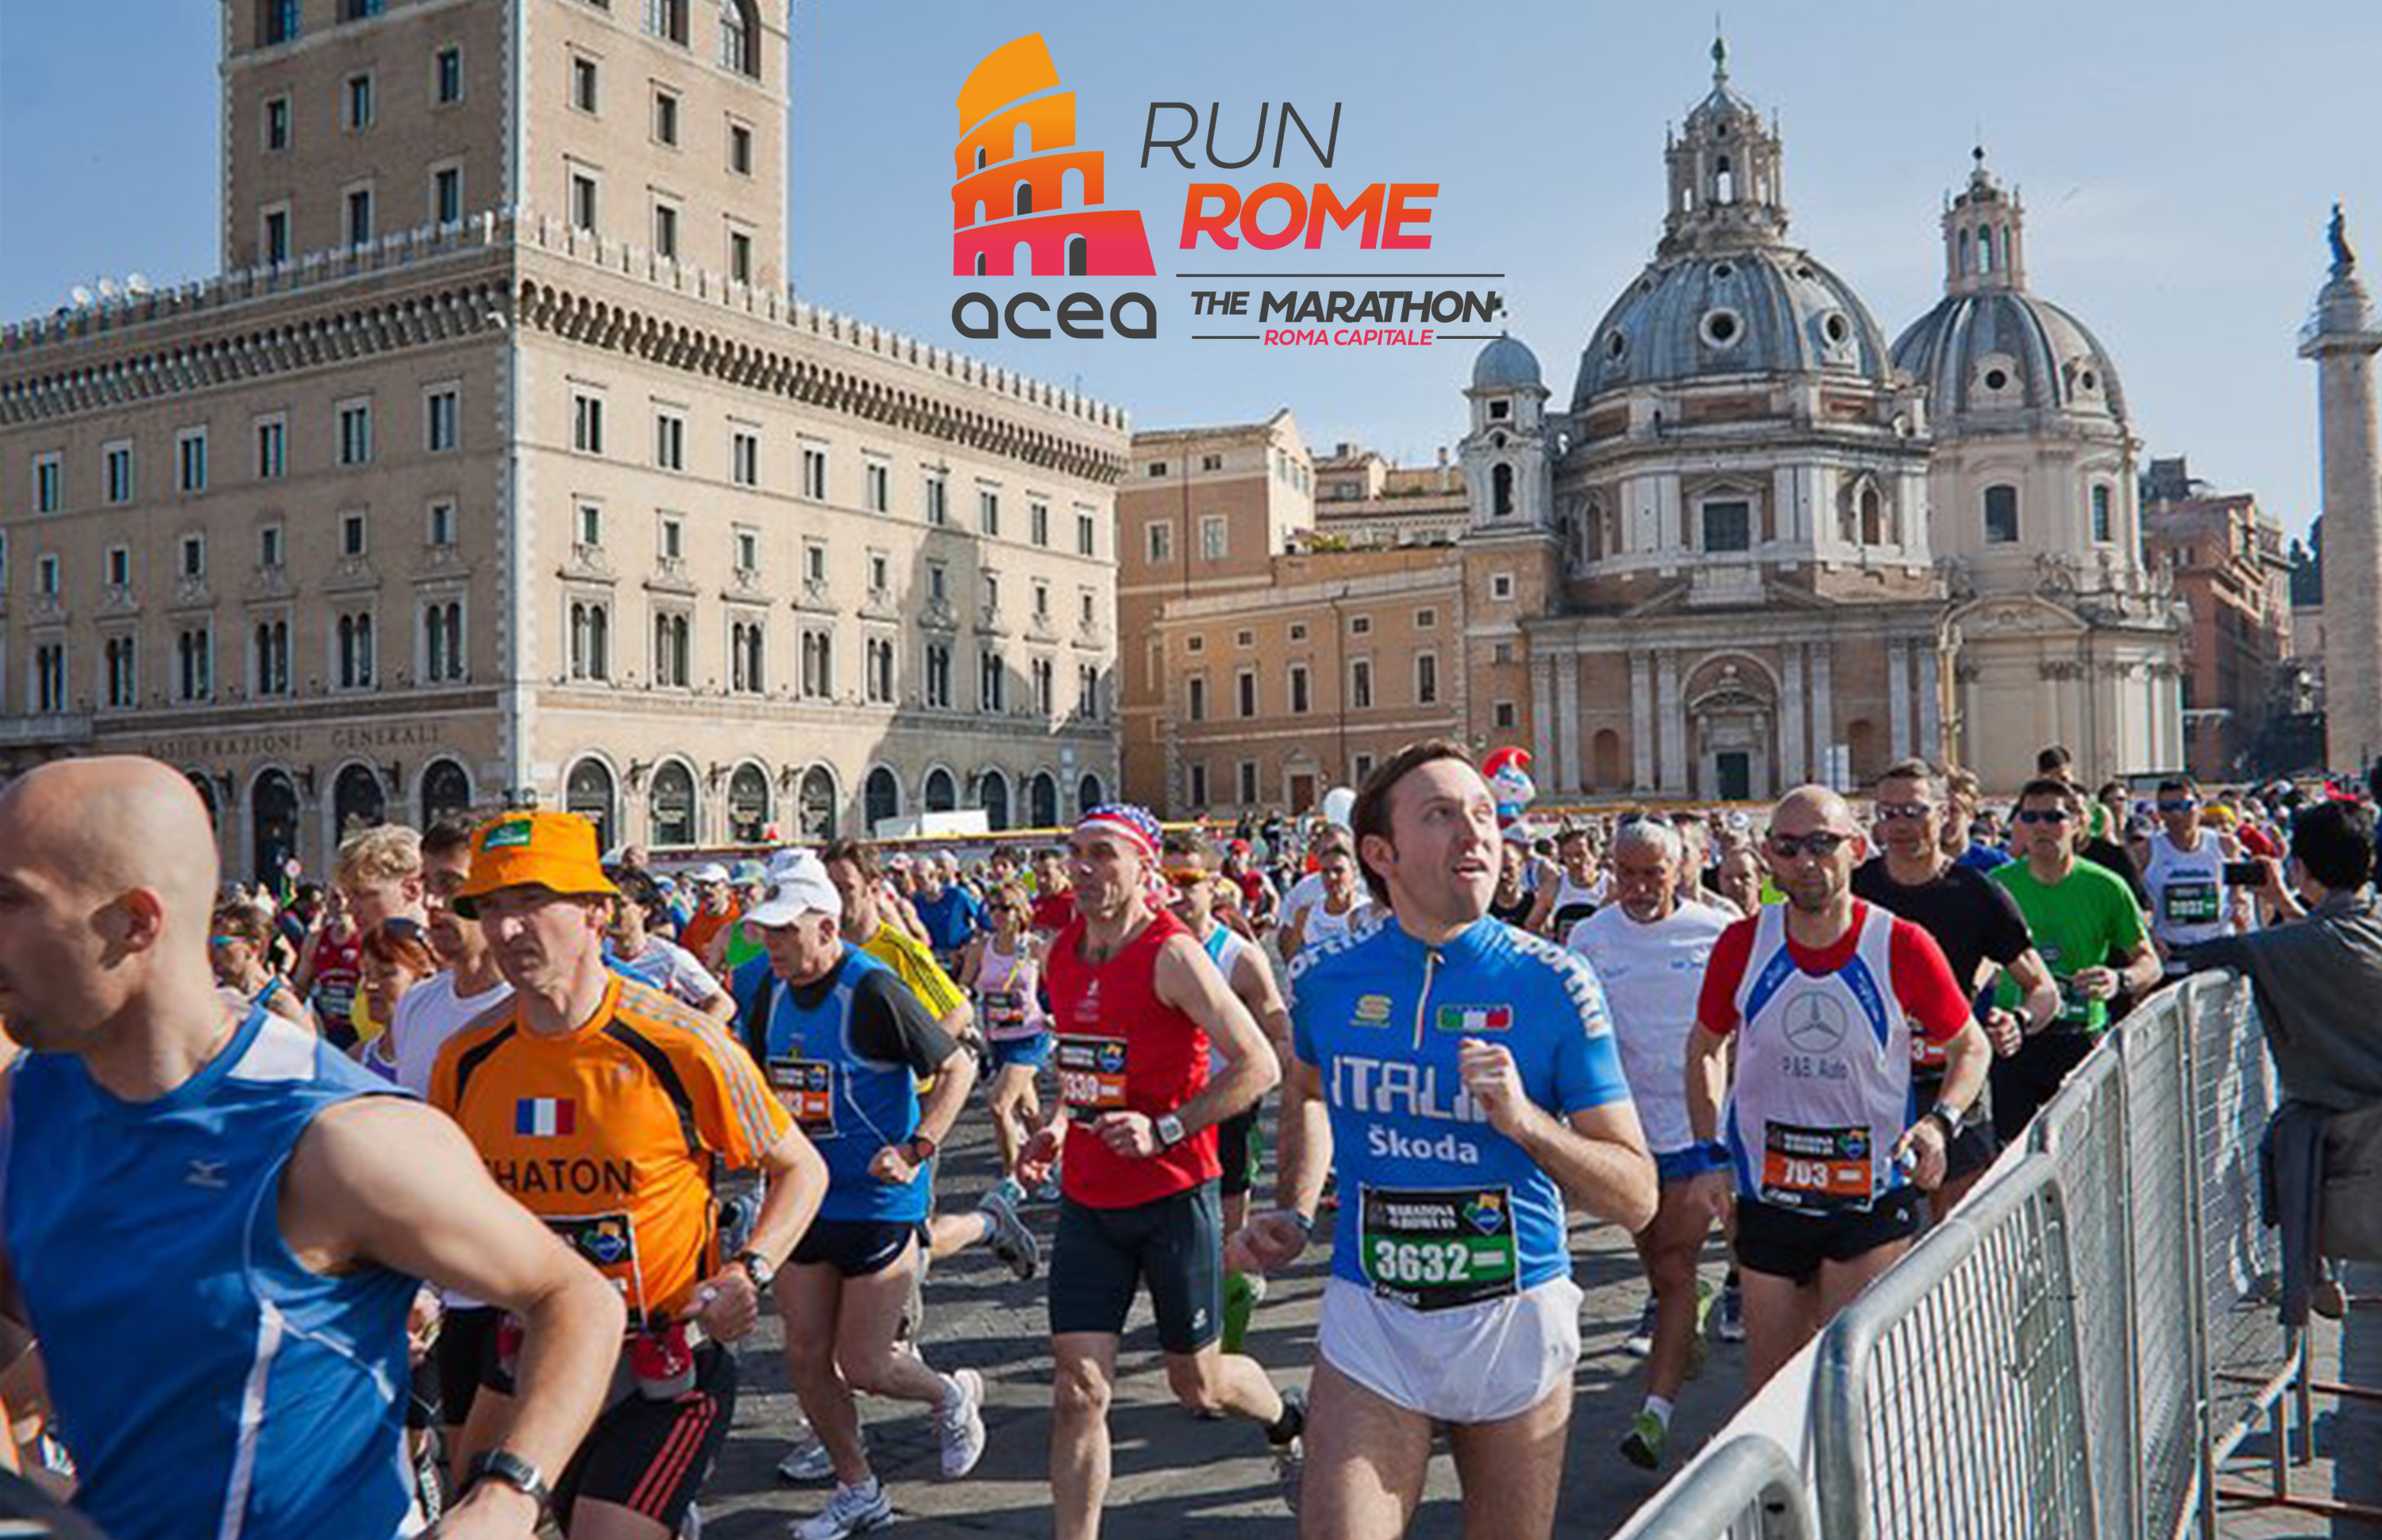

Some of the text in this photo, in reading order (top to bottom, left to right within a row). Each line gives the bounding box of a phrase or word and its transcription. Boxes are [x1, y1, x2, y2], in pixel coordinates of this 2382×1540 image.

[331, 723, 439, 749] GENERALI
[1332, 1054, 1488, 1122] ITALI
[1368, 1123, 1478, 1165] Škoda
[484, 1157, 634, 1195] HATON
[1781, 1156, 1829, 1189] 703
[1374, 1240, 1470, 1282] 3632
